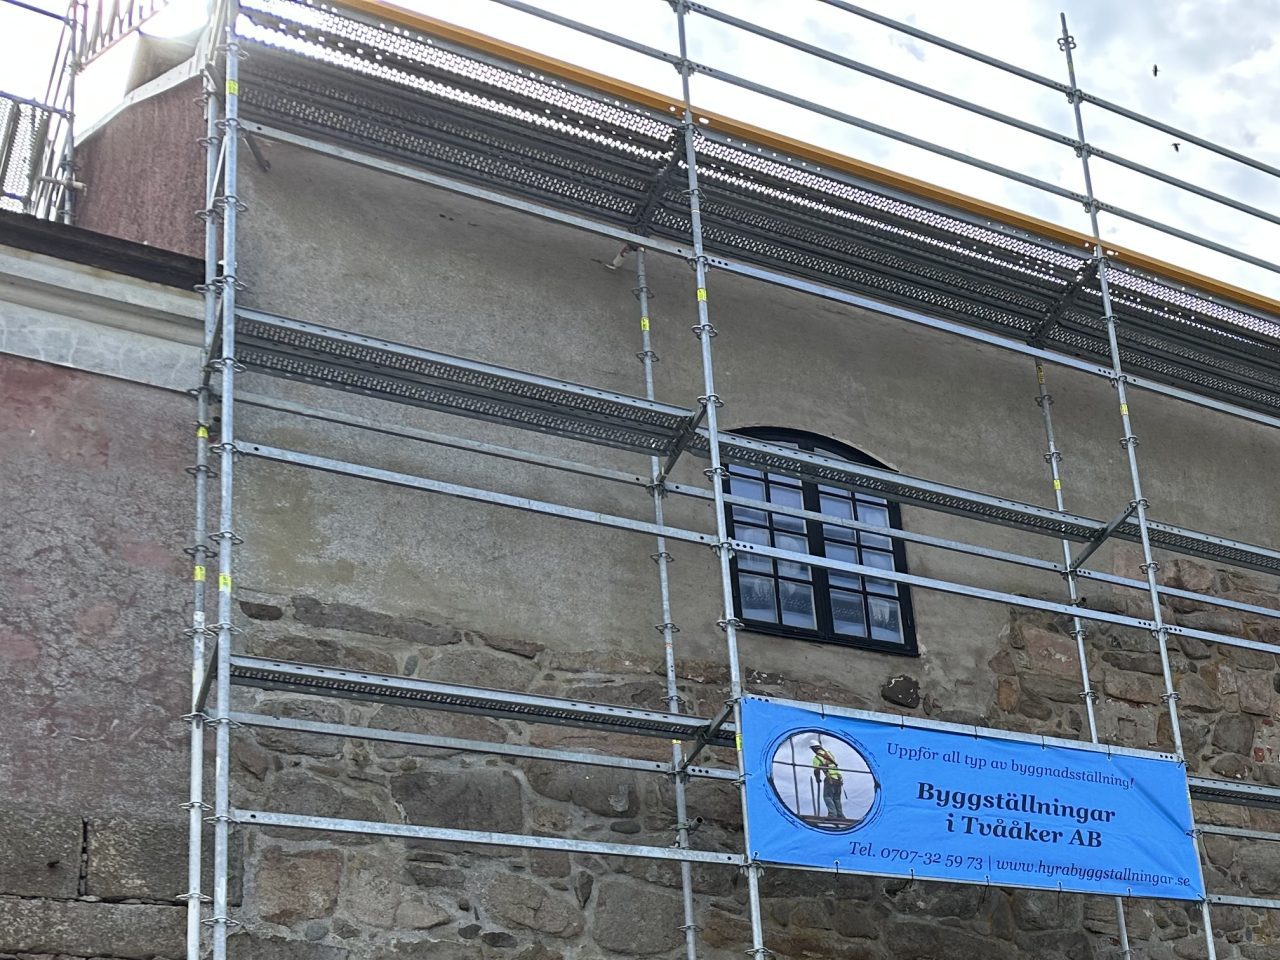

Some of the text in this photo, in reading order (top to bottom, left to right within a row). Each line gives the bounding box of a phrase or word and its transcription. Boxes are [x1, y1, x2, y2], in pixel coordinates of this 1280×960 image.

[887, 742, 1135, 790] Uppför all typ av byggnadsställning!
[916, 781, 1116, 824] Byggställningar
[946, 813, 1102, 848] i Tvååker AB
[849, 841, 876, 858] Tel.
[880, 847, 942, 865] 0707-32
[945, 853, 963, 869] 59
[966, 856, 983, 870] 73
[996, 857, 1191, 887] www.hyrabyggstallningar.se
